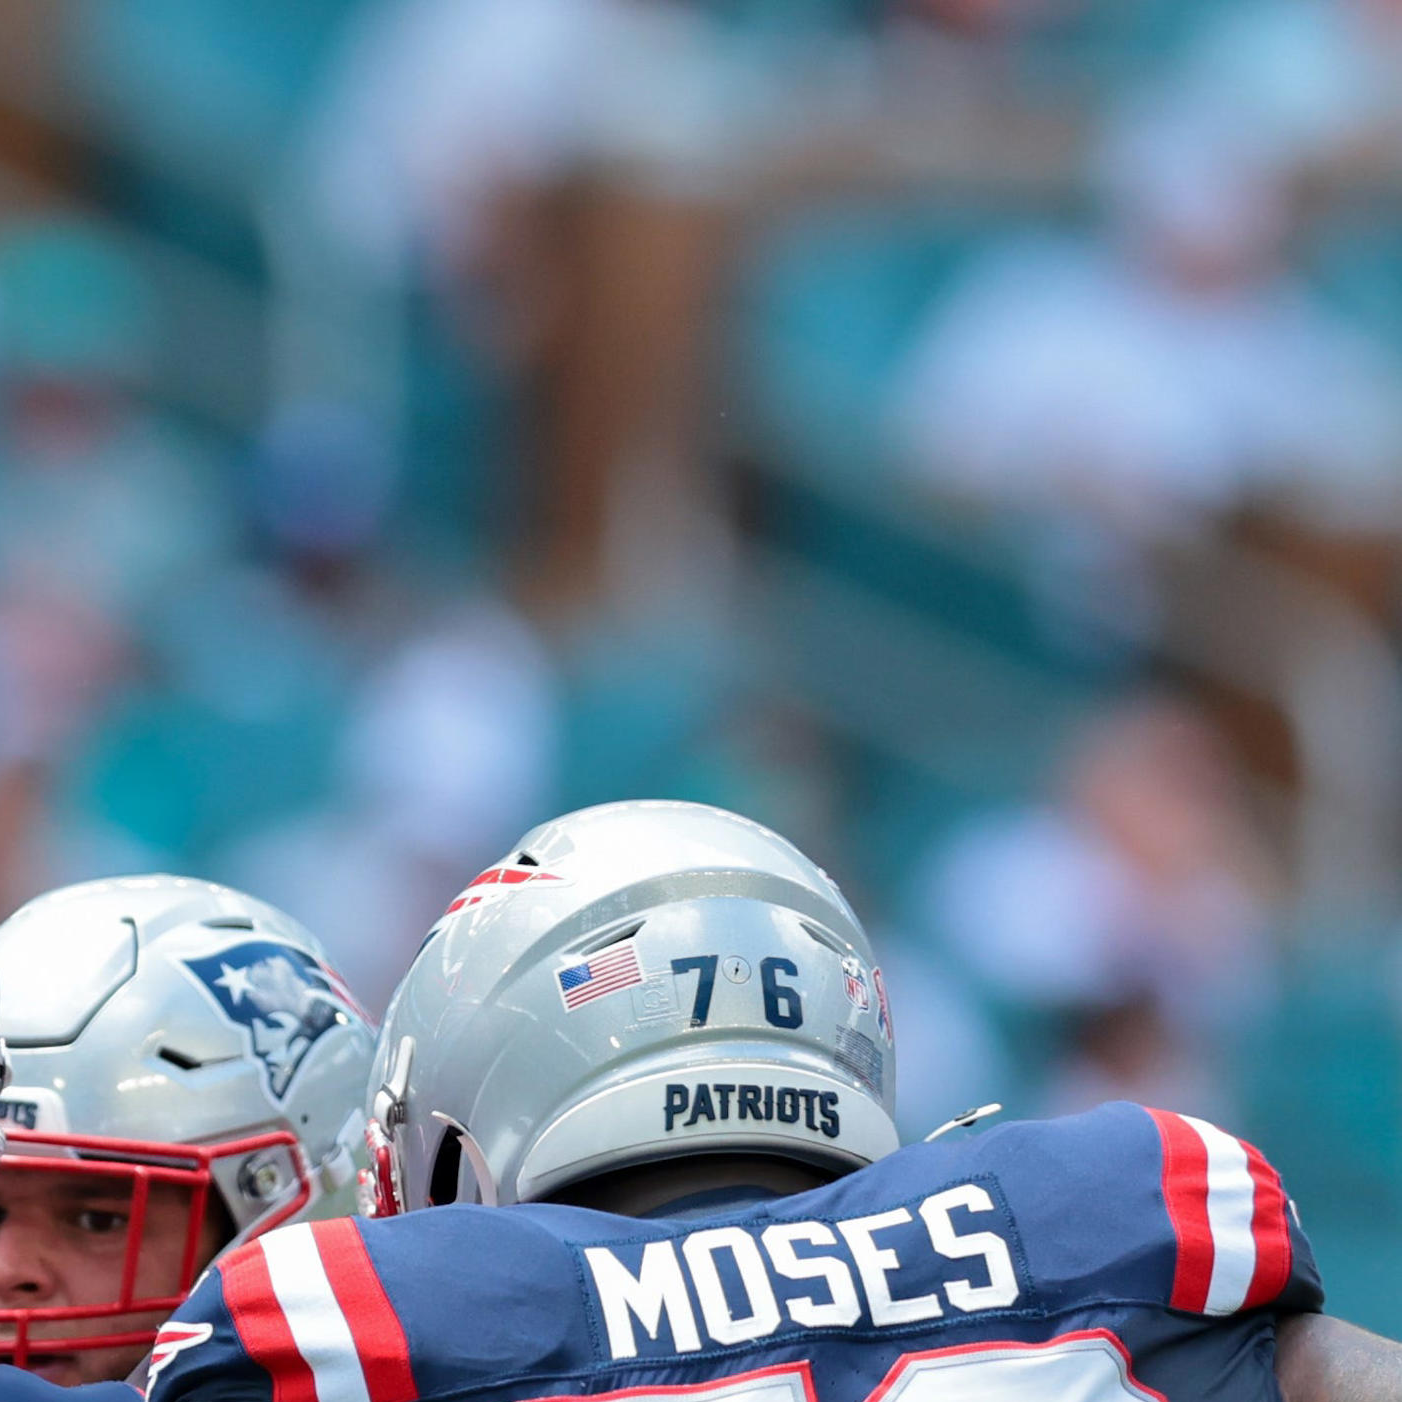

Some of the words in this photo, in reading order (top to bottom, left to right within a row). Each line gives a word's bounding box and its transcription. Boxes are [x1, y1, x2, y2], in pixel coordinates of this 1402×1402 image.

[670, 954, 804, 1030] 76
[663, 1083, 841, 1139] PATRIOTS
[583, 1183, 1019, 1359] MOSES
